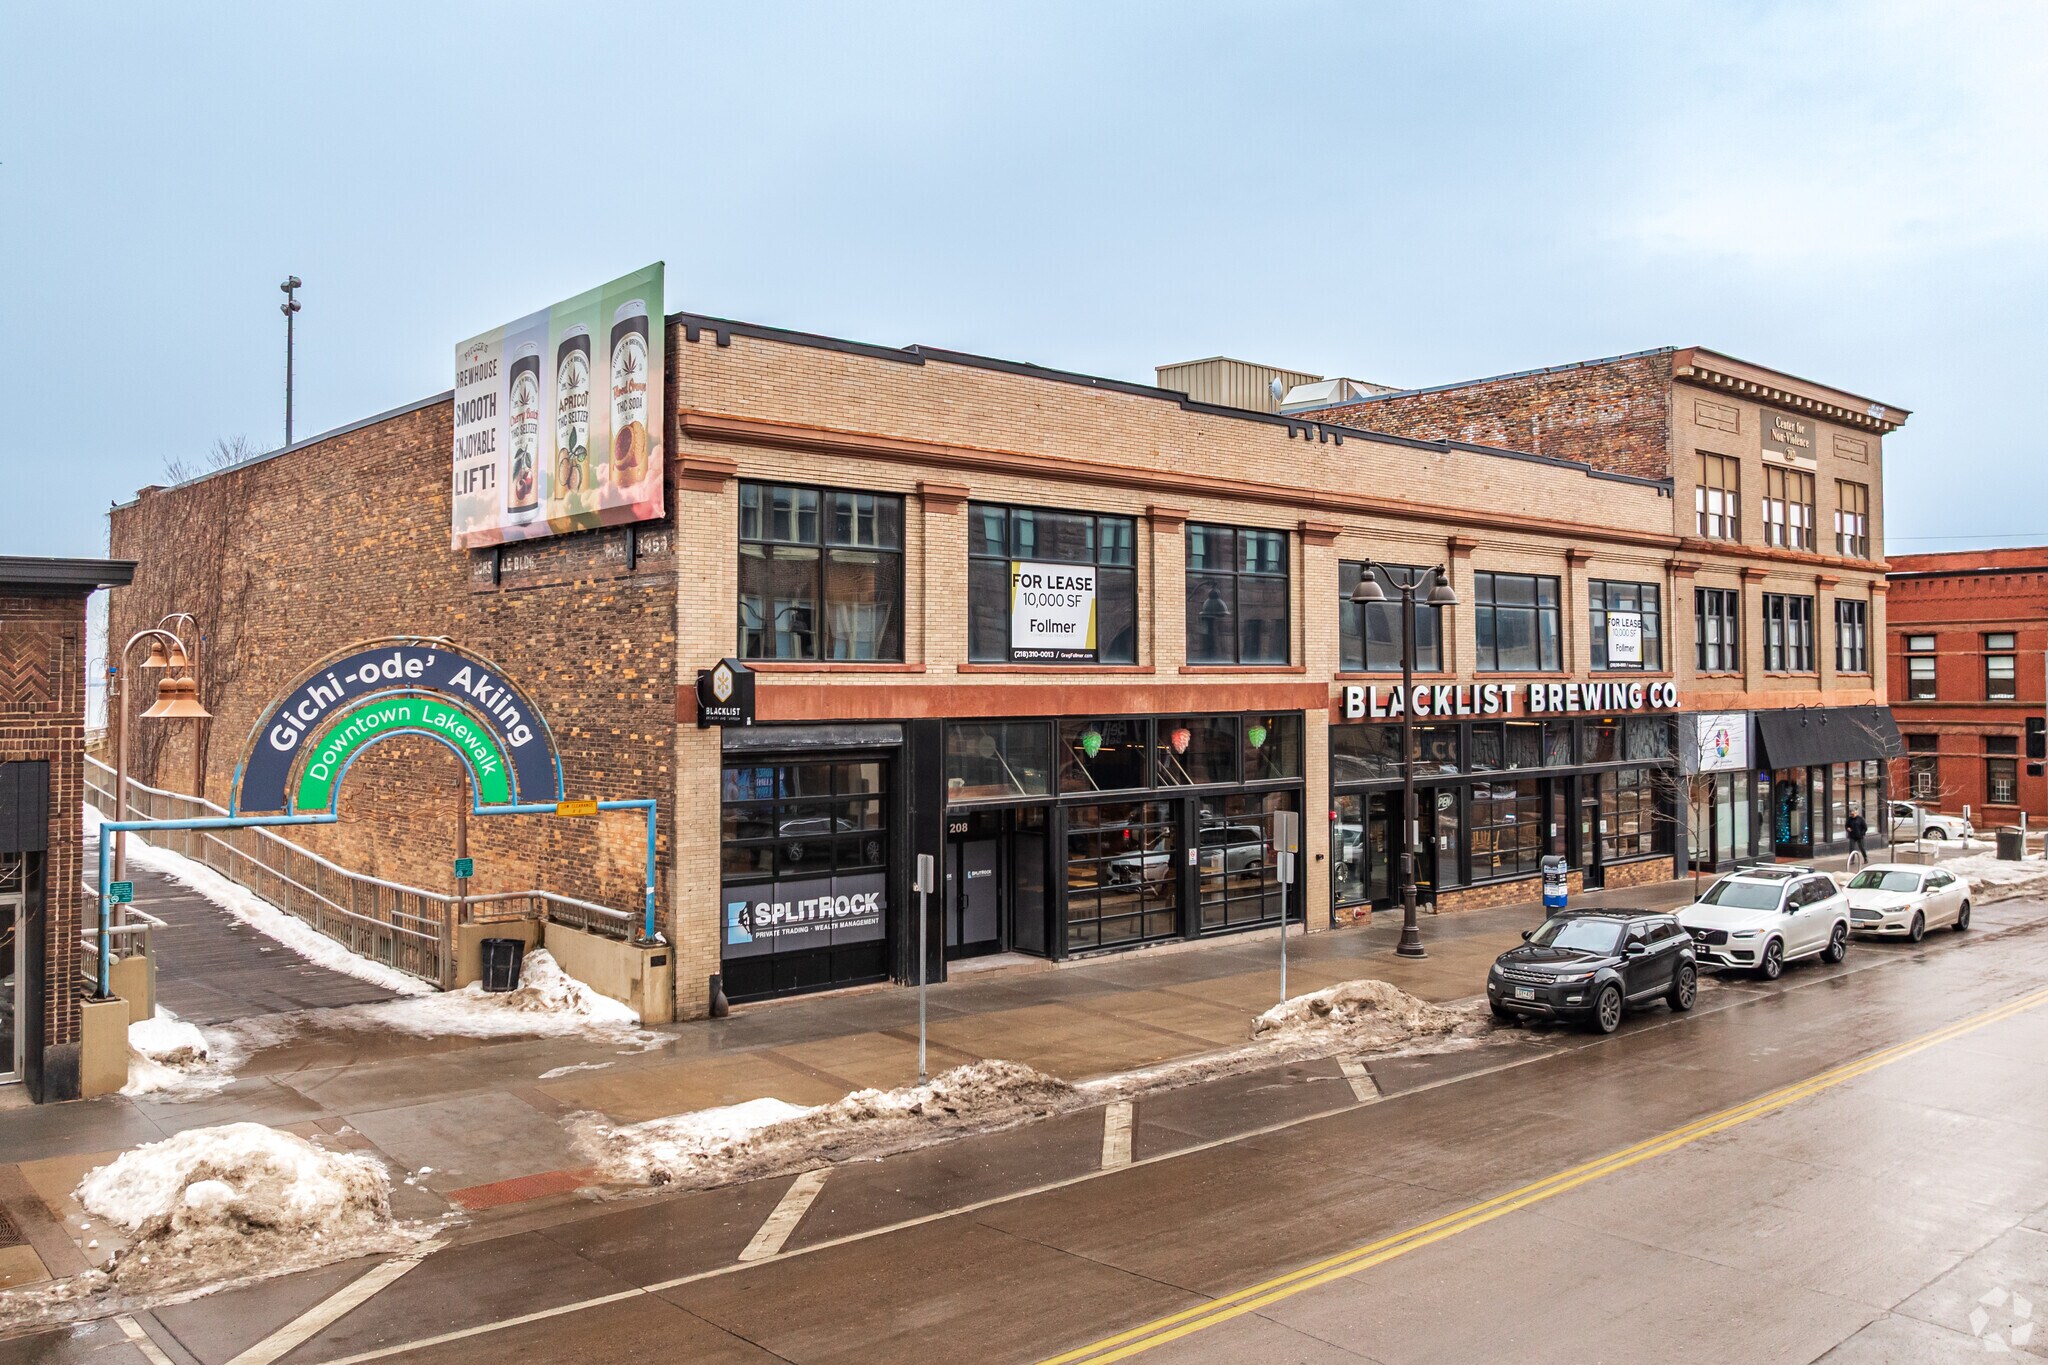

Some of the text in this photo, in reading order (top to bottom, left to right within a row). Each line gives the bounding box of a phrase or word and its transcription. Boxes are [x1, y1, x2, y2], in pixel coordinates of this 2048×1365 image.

[456, 359, 497, 389] BREWHOUSE
[456, 392, 496, 427] SMOOTH
[559, 390, 589, 415] APRICOT
[617, 397, 643, 414] THC SODA
[568, 410, 589, 424] SELTZER
[1775, 416, 1805, 434] Center for
[520, 423, 538, 435] SELTZER
[1771, 428, 1810, 448] Non-Violence
[455, 428, 496, 461] ENJOYABLE
[455, 463, 495, 496] LIFT!
[1012, 573, 1093, 591] FOR LEASE
[1023, 592, 1083, 608] 10,000 SF
[1030, 619, 1076, 633] Follmer
[1608, 617, 1642, 629] FOR LEASE
[1616, 643, 1635, 652] Follmer
[448, 665, 534, 749] Akiing
[1345, 681, 1681, 719] BLACKLIST BREWING CO.
[705, 707, 741, 716] BLACKLIST
[310, 705, 496, 782] Downtown Lakewalk
[949, 822, 968, 834] 208
[755, 892, 880, 927] SPLITROCK
[755, 917, 880, 939] PRIVATE TRADING WEALTH MANAGEMENT
